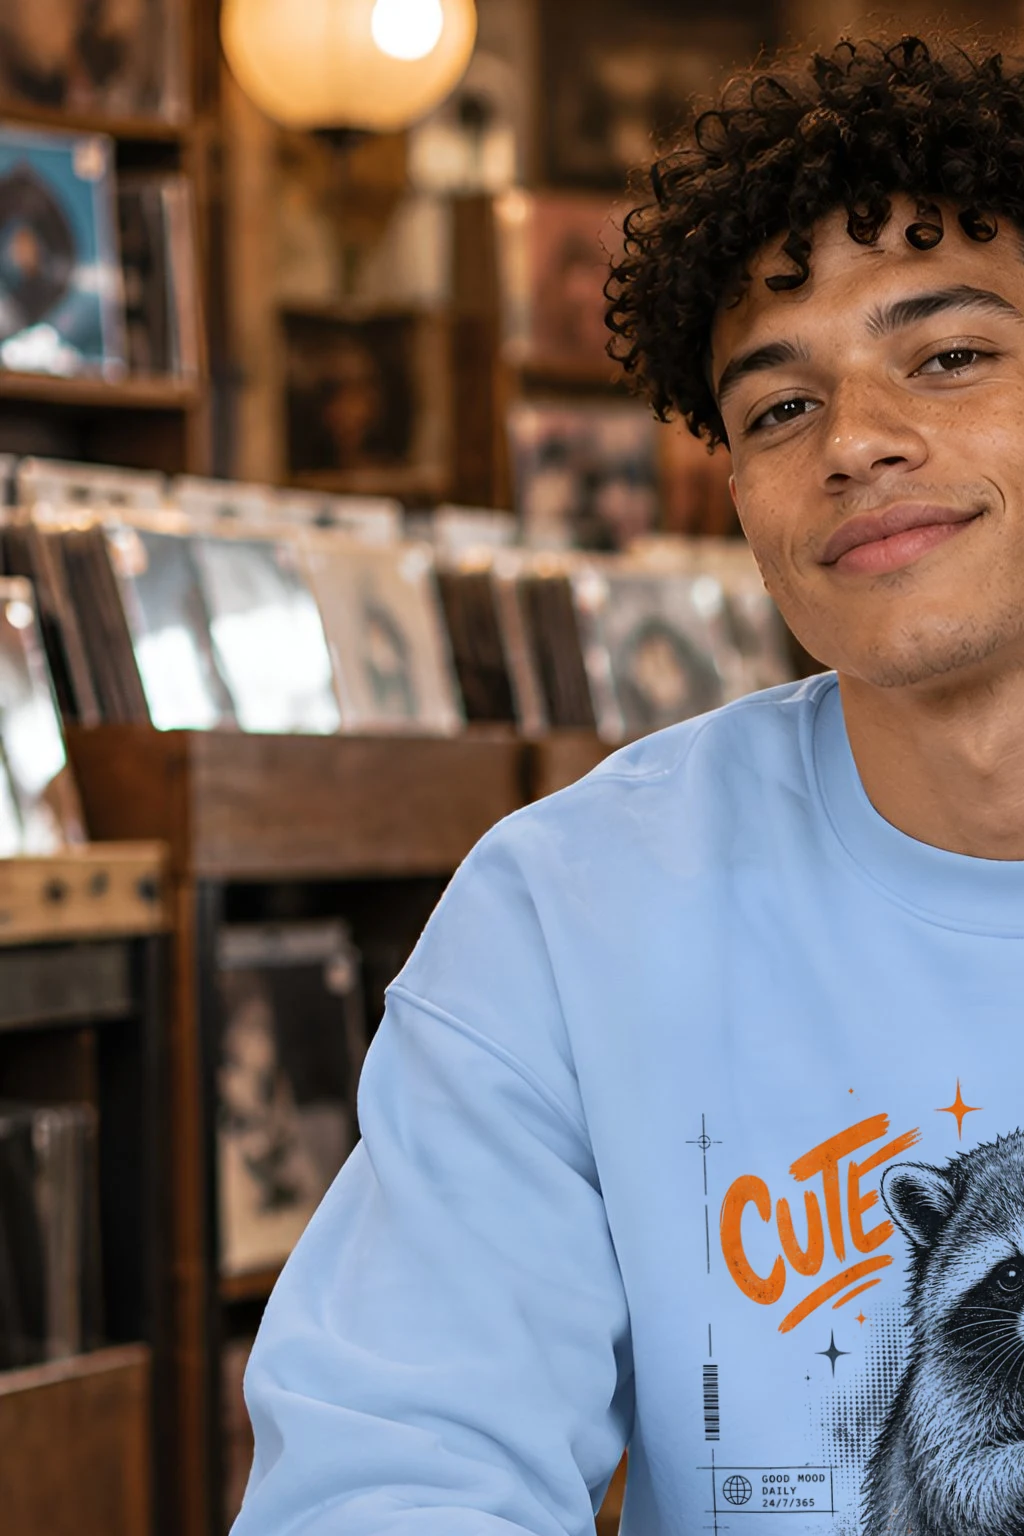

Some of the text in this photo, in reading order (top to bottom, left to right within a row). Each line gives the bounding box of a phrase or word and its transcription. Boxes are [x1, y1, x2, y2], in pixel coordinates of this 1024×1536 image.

[720, 1112, 923, 1305] CUTE
[761, 1473, 826, 1484] GOOD MOOD
[761, 1486, 797, 1496] DAILY
[762, 1498, 815, 1508] 24/7/365
